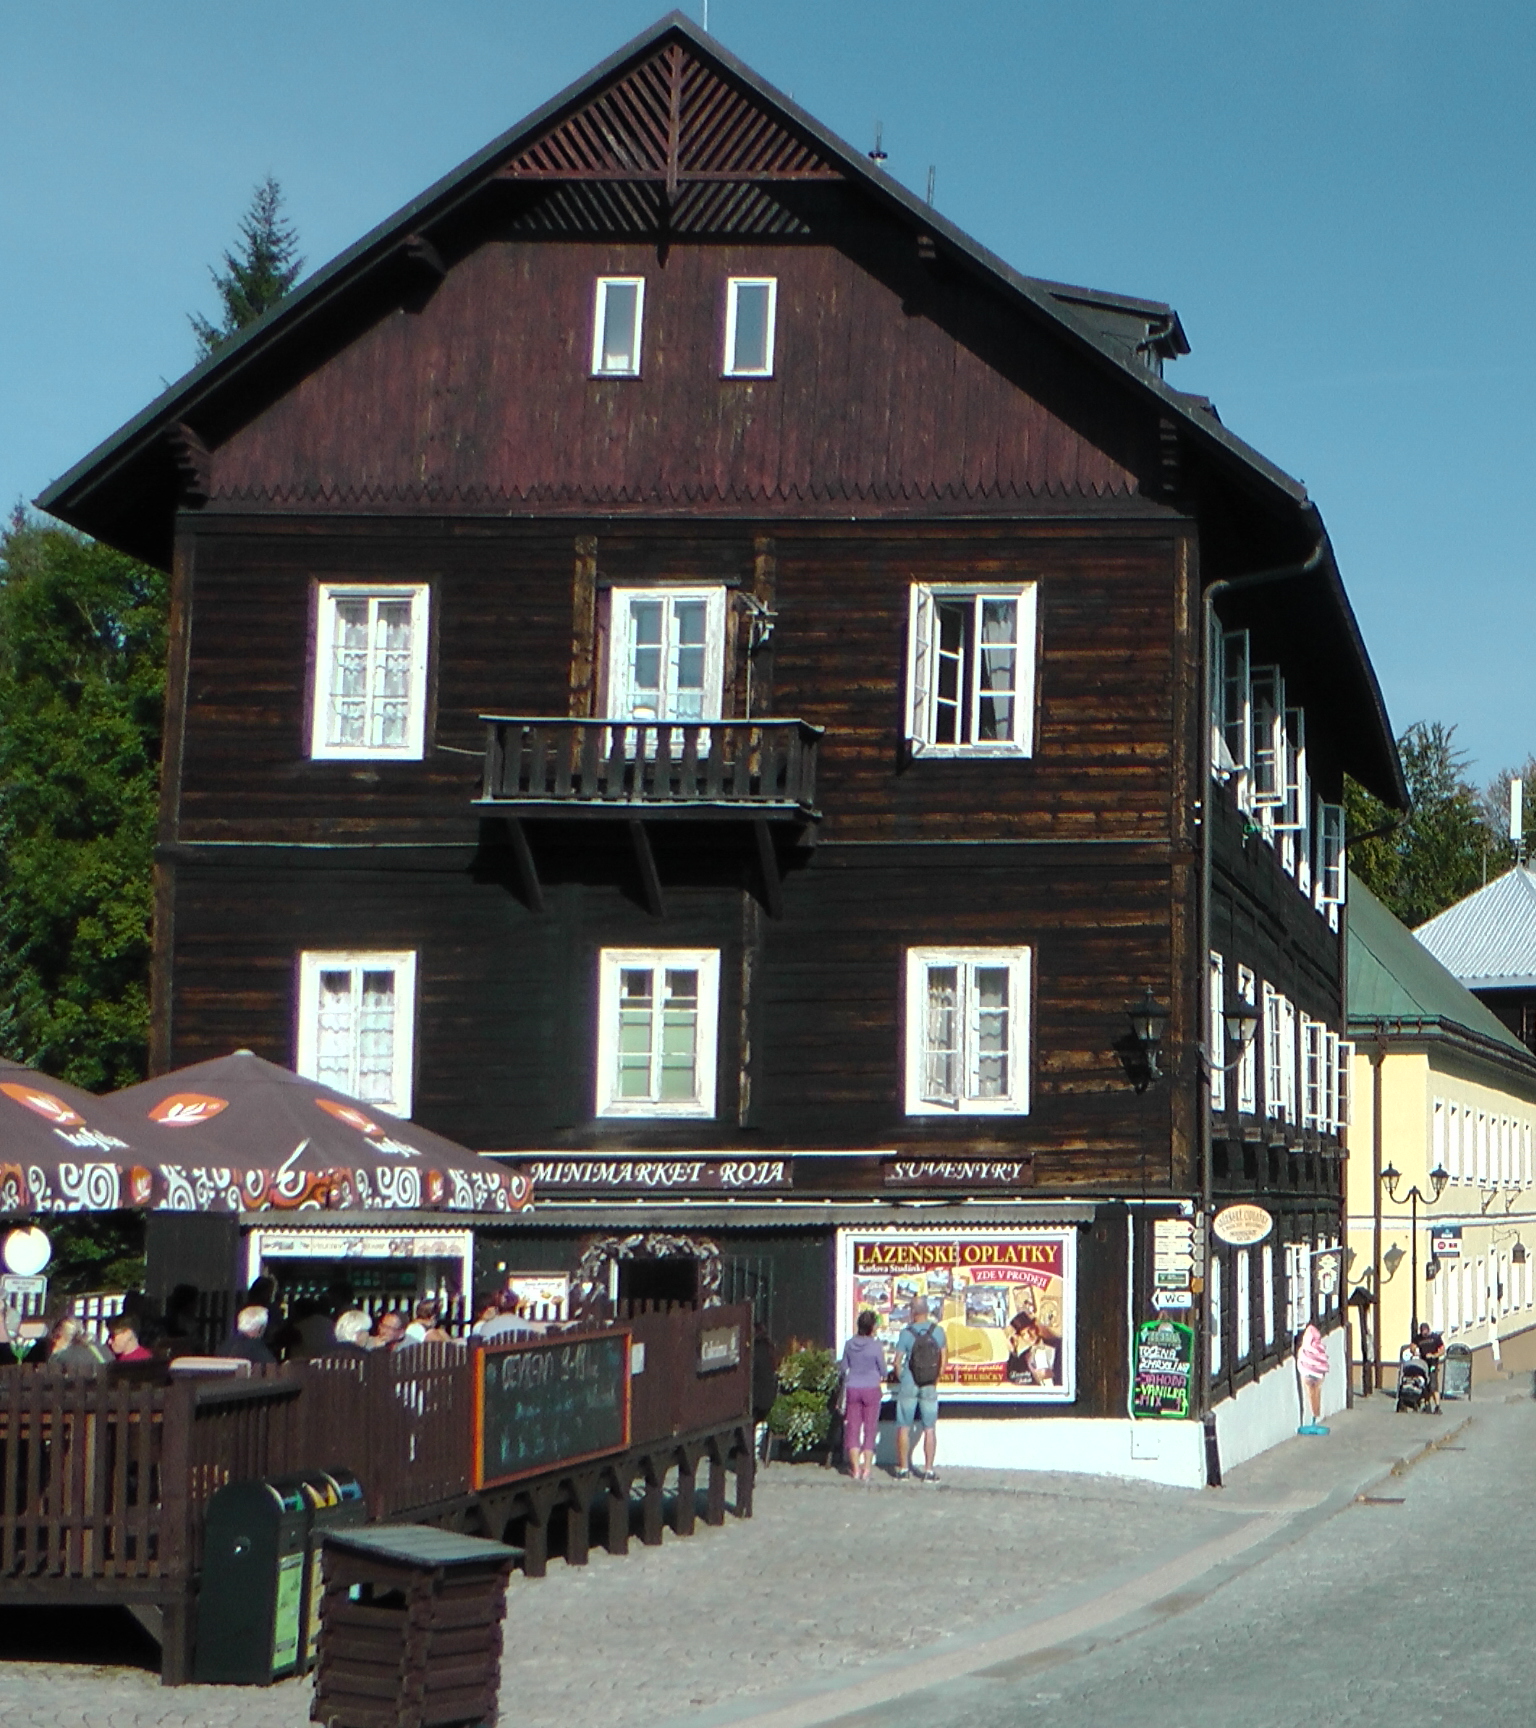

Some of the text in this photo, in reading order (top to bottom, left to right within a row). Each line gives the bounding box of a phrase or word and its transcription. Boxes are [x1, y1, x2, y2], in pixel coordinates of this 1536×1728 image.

[531, 1161, 705, 1186] MINIMARKET
[720, 1161, 784, 1186] ROJA
[858, 1241, 1058, 1263] LÁZEŇSKÉ OPLATKY
[858, 1264, 889, 1273] Karlova
[976, 1271, 996, 1280] ZDE
[998, 1271, 1005, 1279] V
[1165, 1294, 1185, 1304] WC
